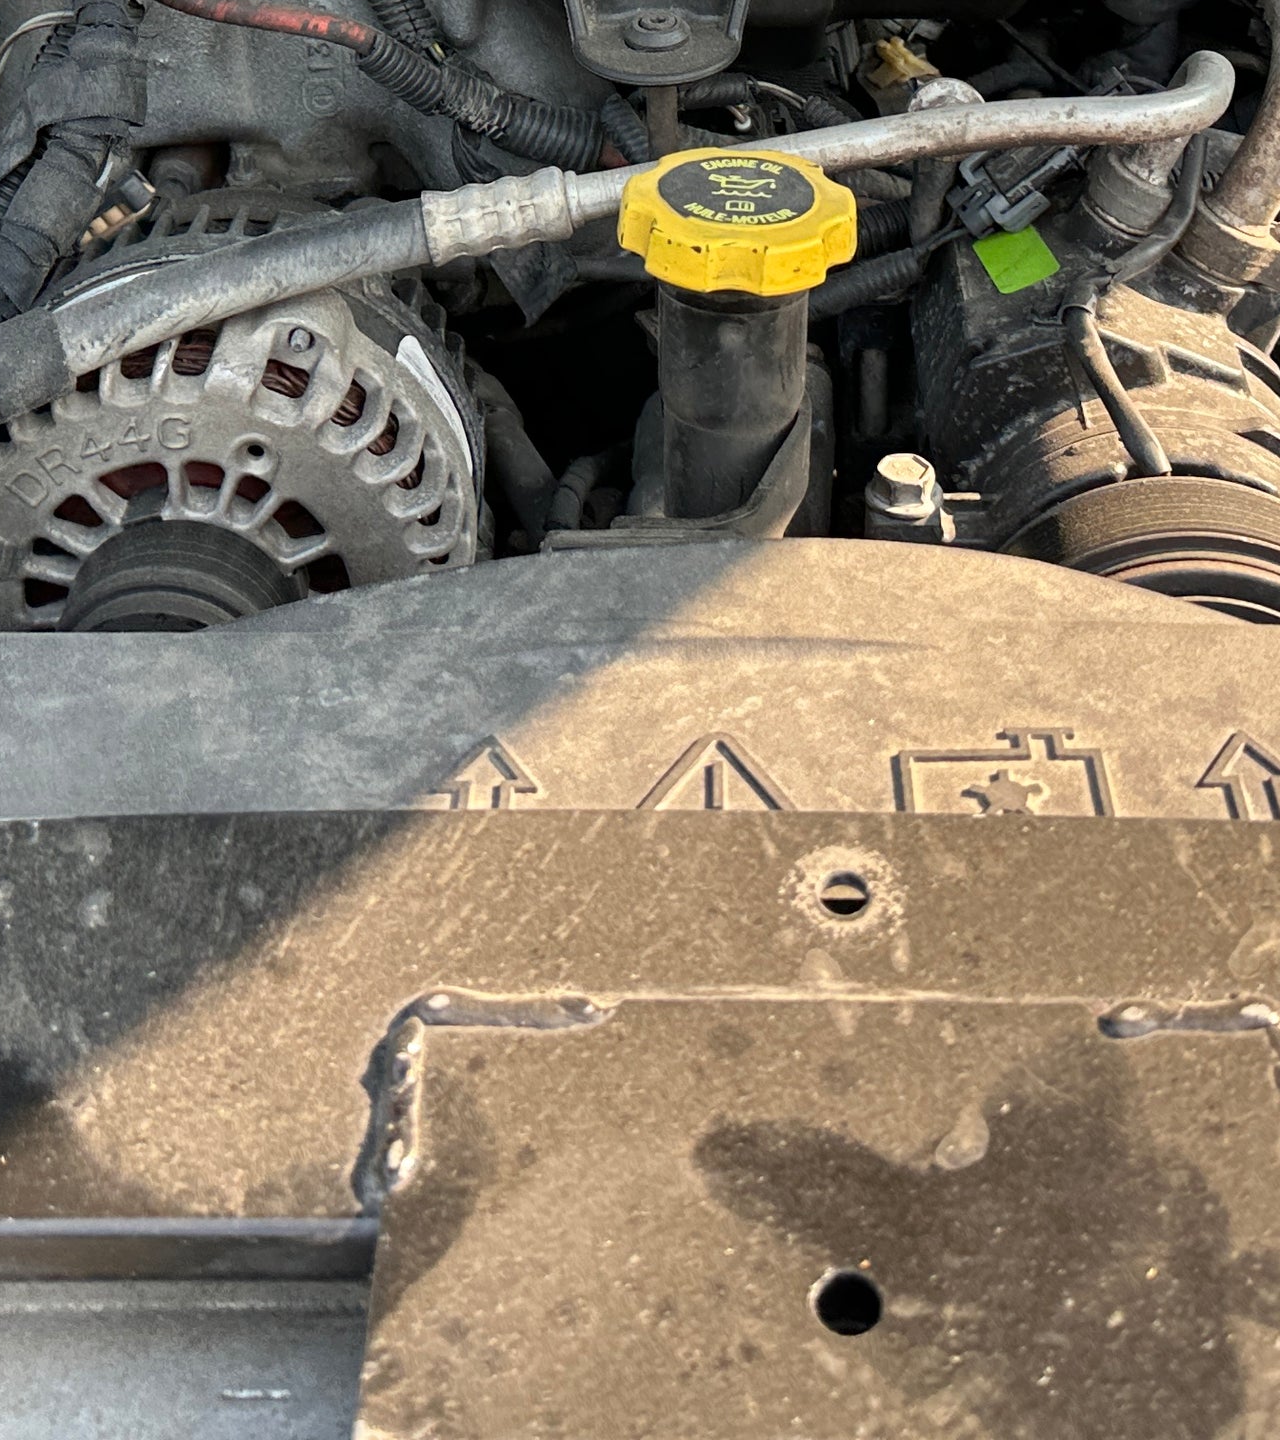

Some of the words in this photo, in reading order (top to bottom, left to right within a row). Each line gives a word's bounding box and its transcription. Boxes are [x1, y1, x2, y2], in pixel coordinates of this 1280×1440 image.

[699, 158, 759, 171] ENGINE
[759, 161, 784, 175] OIL
[683, 201, 799, 226] HUILE-MOTEUR
[4, 413, 192, 508] DR44G
